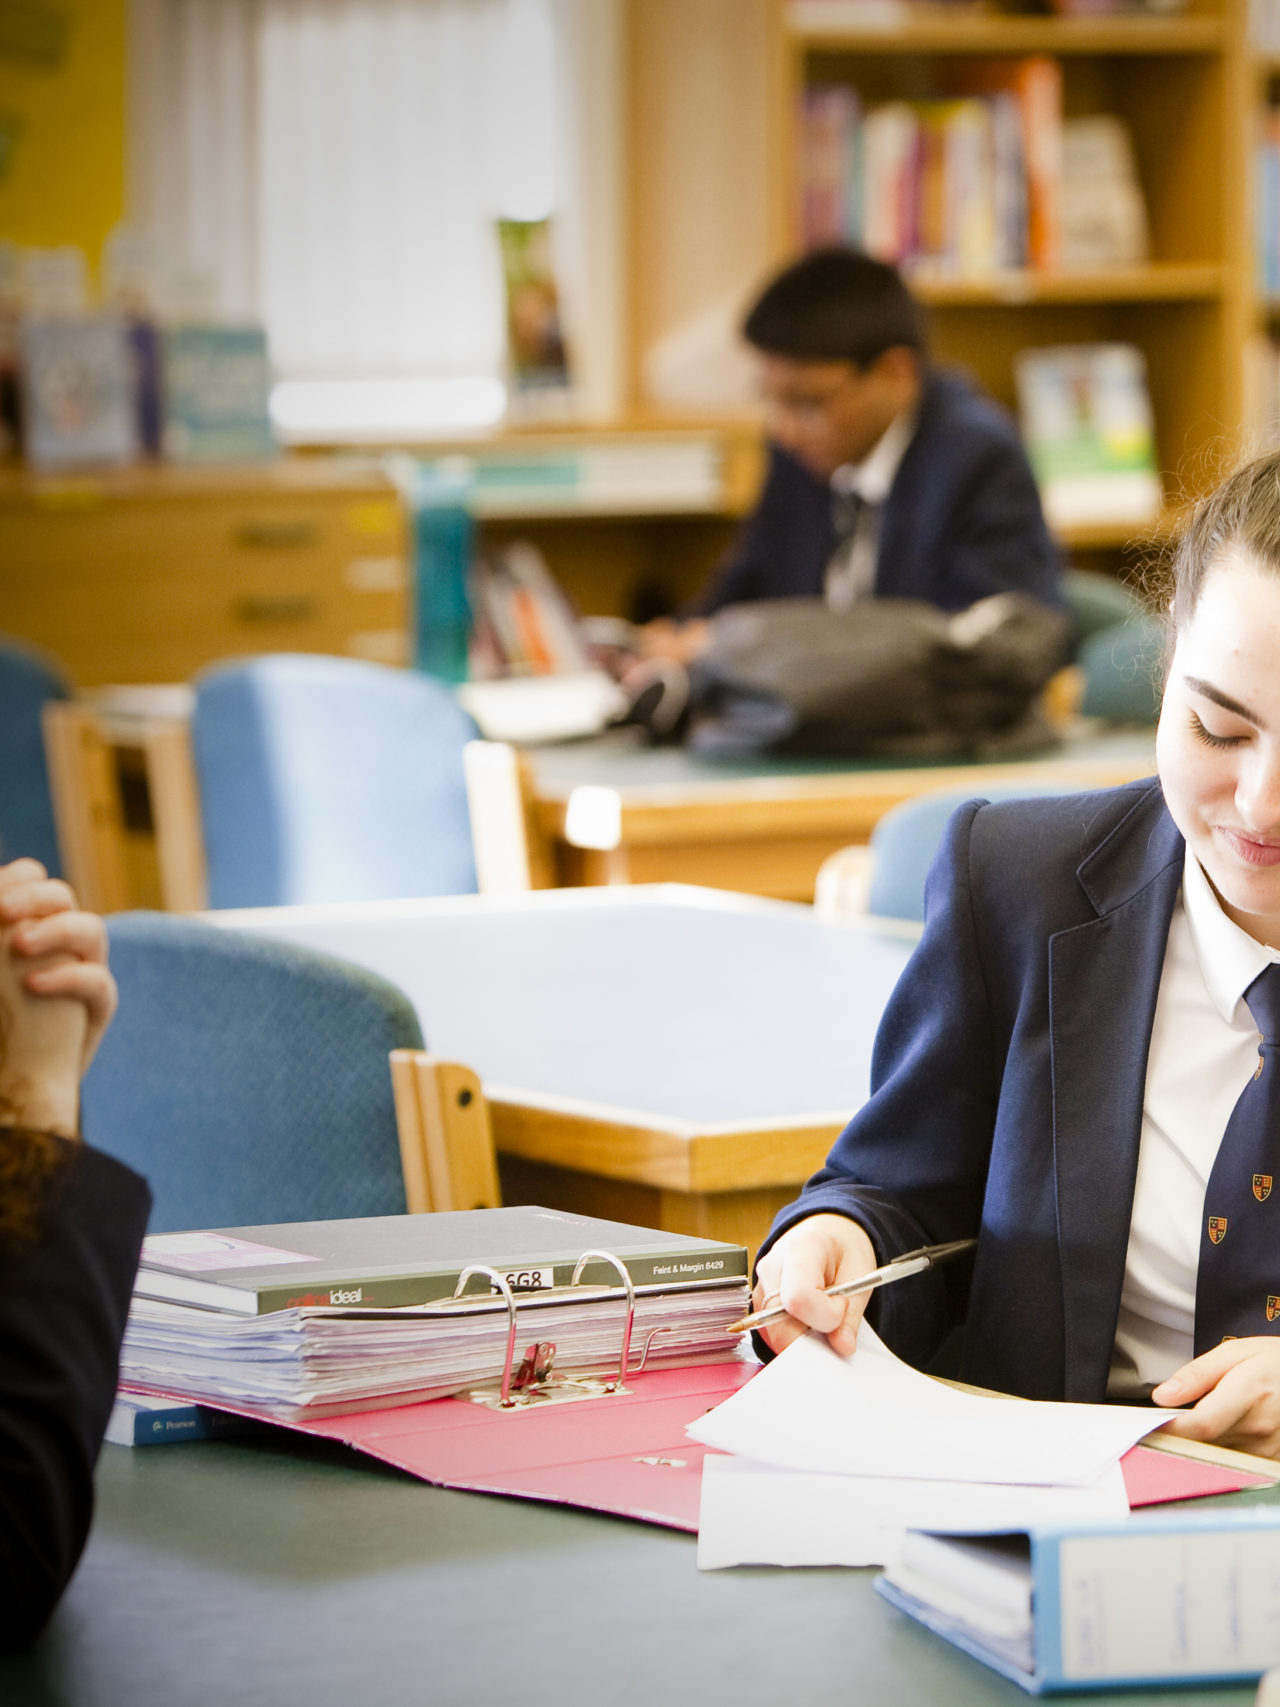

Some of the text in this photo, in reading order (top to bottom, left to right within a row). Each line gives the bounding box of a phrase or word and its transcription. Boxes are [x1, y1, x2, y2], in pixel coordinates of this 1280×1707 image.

[653, 1266, 671, 1275] Feint
[672, 1264, 679, 1273] &
[680, 1262, 704, 1273] Margin
[330, 1288, 362, 1304] ideal
[166, 1420, 196, 1430] Pearson
